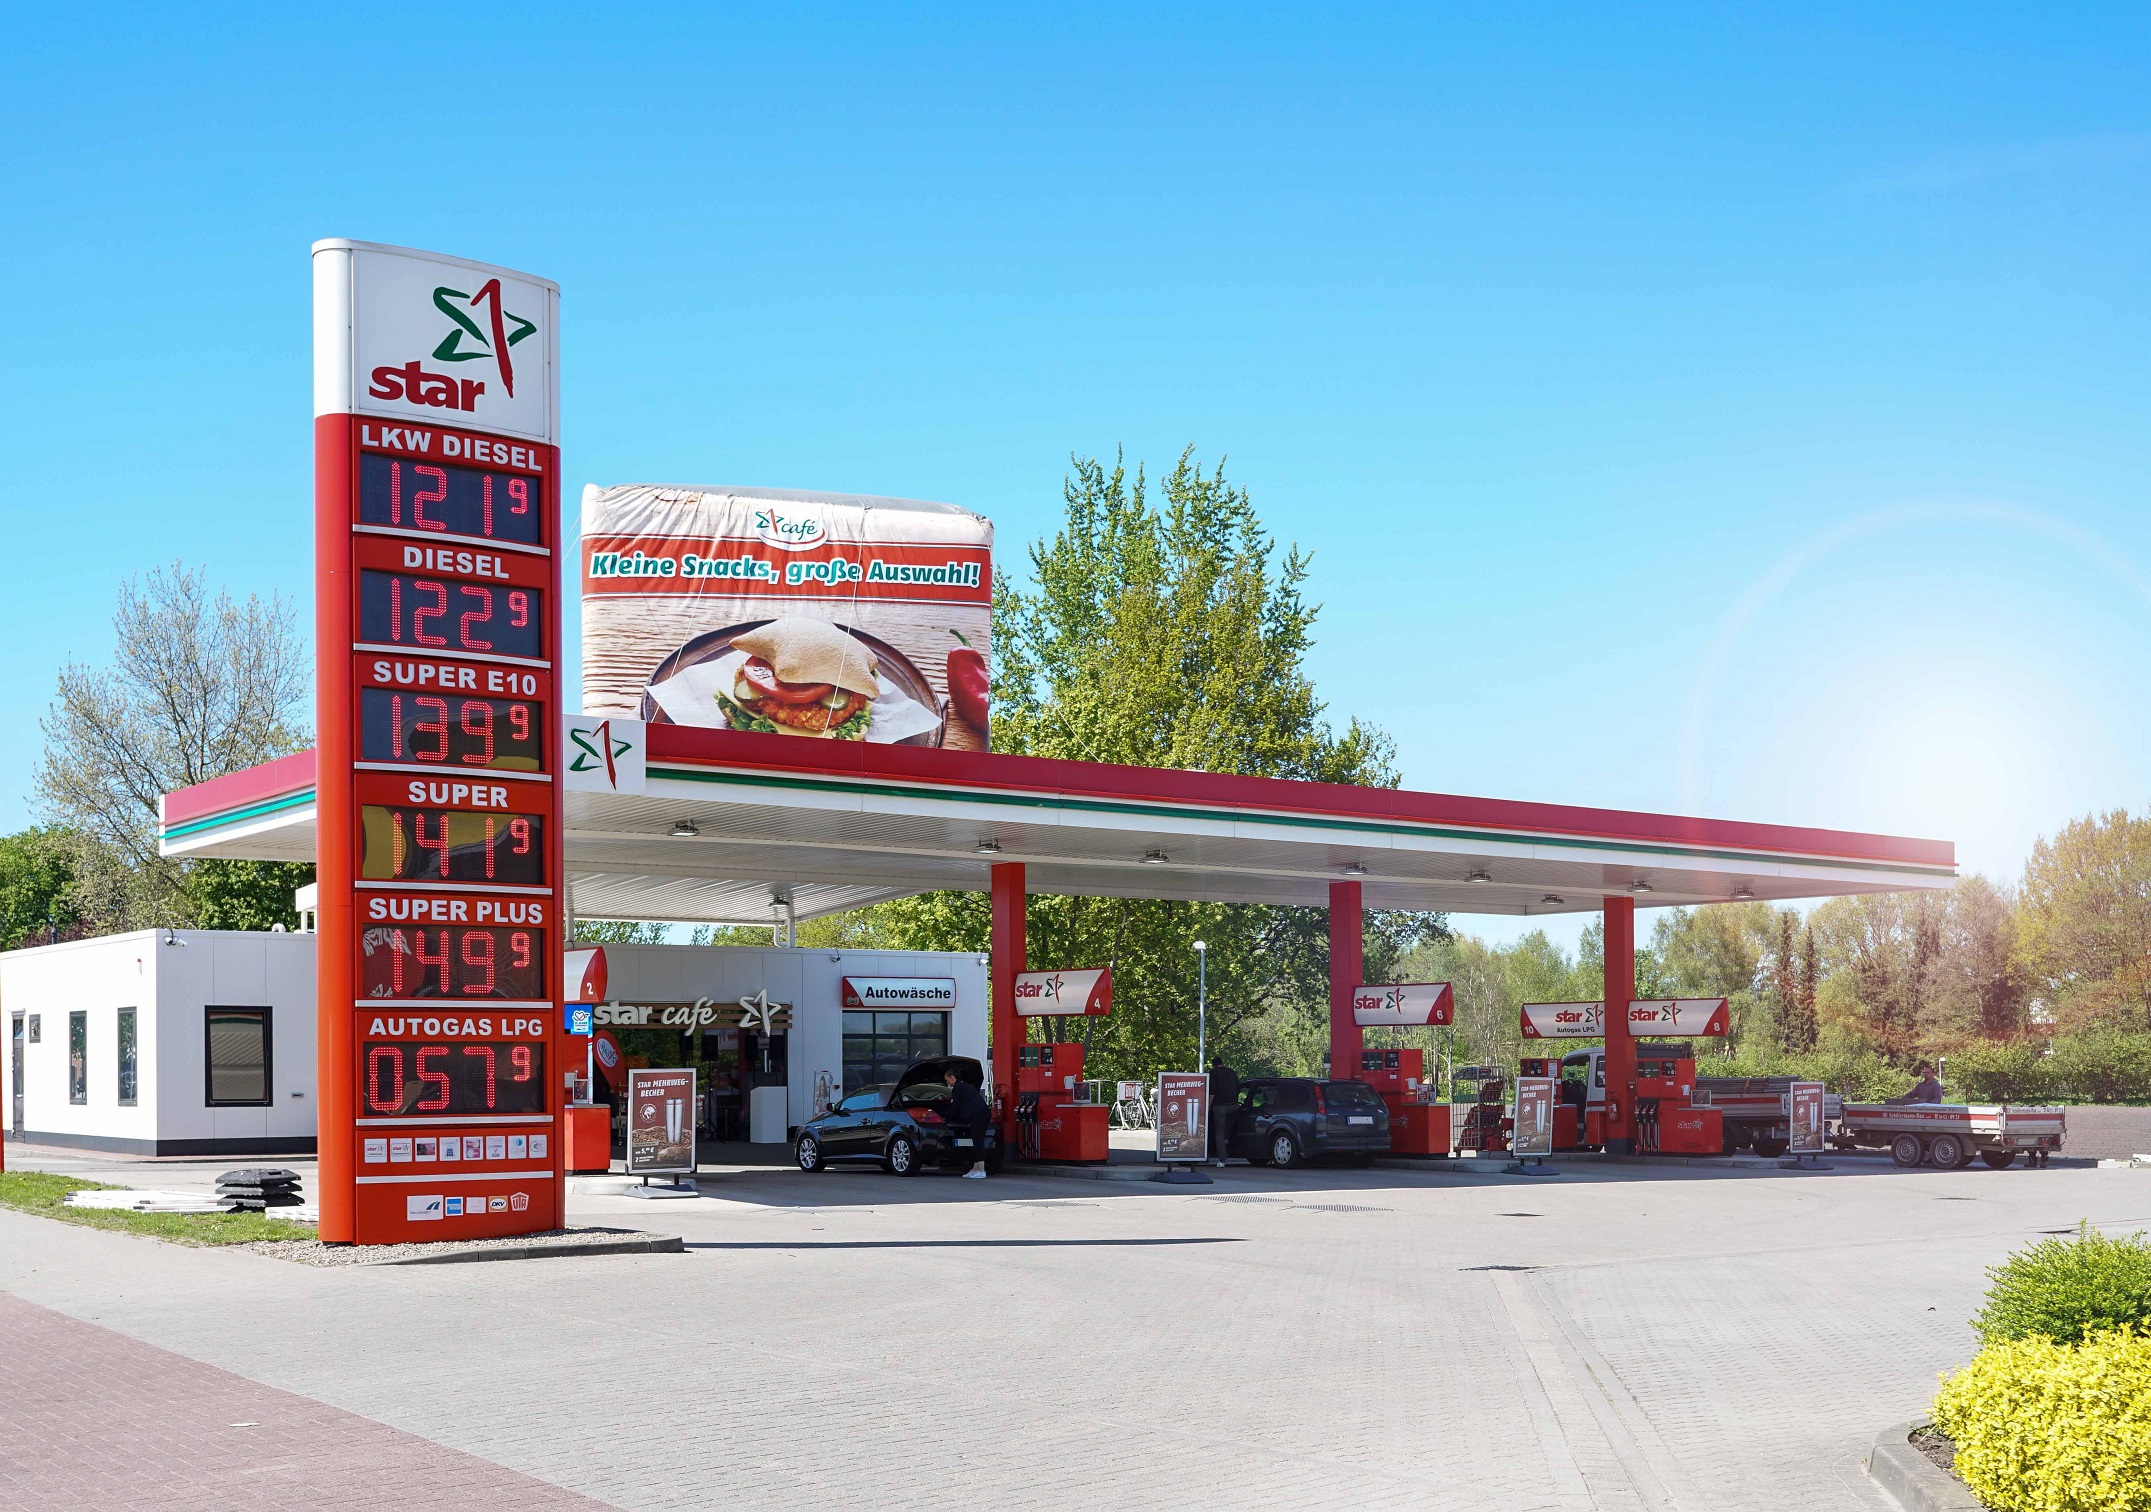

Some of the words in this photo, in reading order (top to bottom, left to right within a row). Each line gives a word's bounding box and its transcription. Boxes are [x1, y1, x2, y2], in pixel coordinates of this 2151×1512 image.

[369, 361, 485, 412] star
[361, 424, 431, 453] LKW
[443, 435, 543, 471] DIESEL
[779, 520, 818, 541] café
[403, 546, 510, 579] DIESEL
[590, 551, 675, 578] Kleine
[682, 556, 779, 584] Snacks,
[787, 558, 861, 584] große
[869, 563, 981, 589] Auswahl!
[373, 660, 477, 690] SUPER
[488, 670, 537, 695] E10
[408, 781, 509, 808] SUPER
[369, 897, 468, 922] SUPER
[476, 901, 543, 924] PLUS
[586, 982, 594, 995] 2
[864, 986, 952, 999] Autowäsche
[1015, 980, 1043, 998] star
[1094, 998, 1101, 1009] 4
[1354, 994, 1384, 1010] star
[593, 1000, 653, 1025] star
[660, 997, 718, 1036] café
[1436, 1009, 1444, 1020] 6
[1555, 1009, 1583, 1023] star
[1629, 1007, 1659, 1022] star
[369, 1018, 493, 1036] AUTOGAS
[501, 1019, 543, 1036] LPG
[1524, 1025, 1534, 1035] 10
[1556, 1026, 1582, 1034] Autogas
[1713, 1022, 1721, 1032] 8
[637, 1081, 652, 1089] STAR
[652, 1078, 690, 1088] MEHRWEG-
[640, 1089, 665, 1097] BECHER
